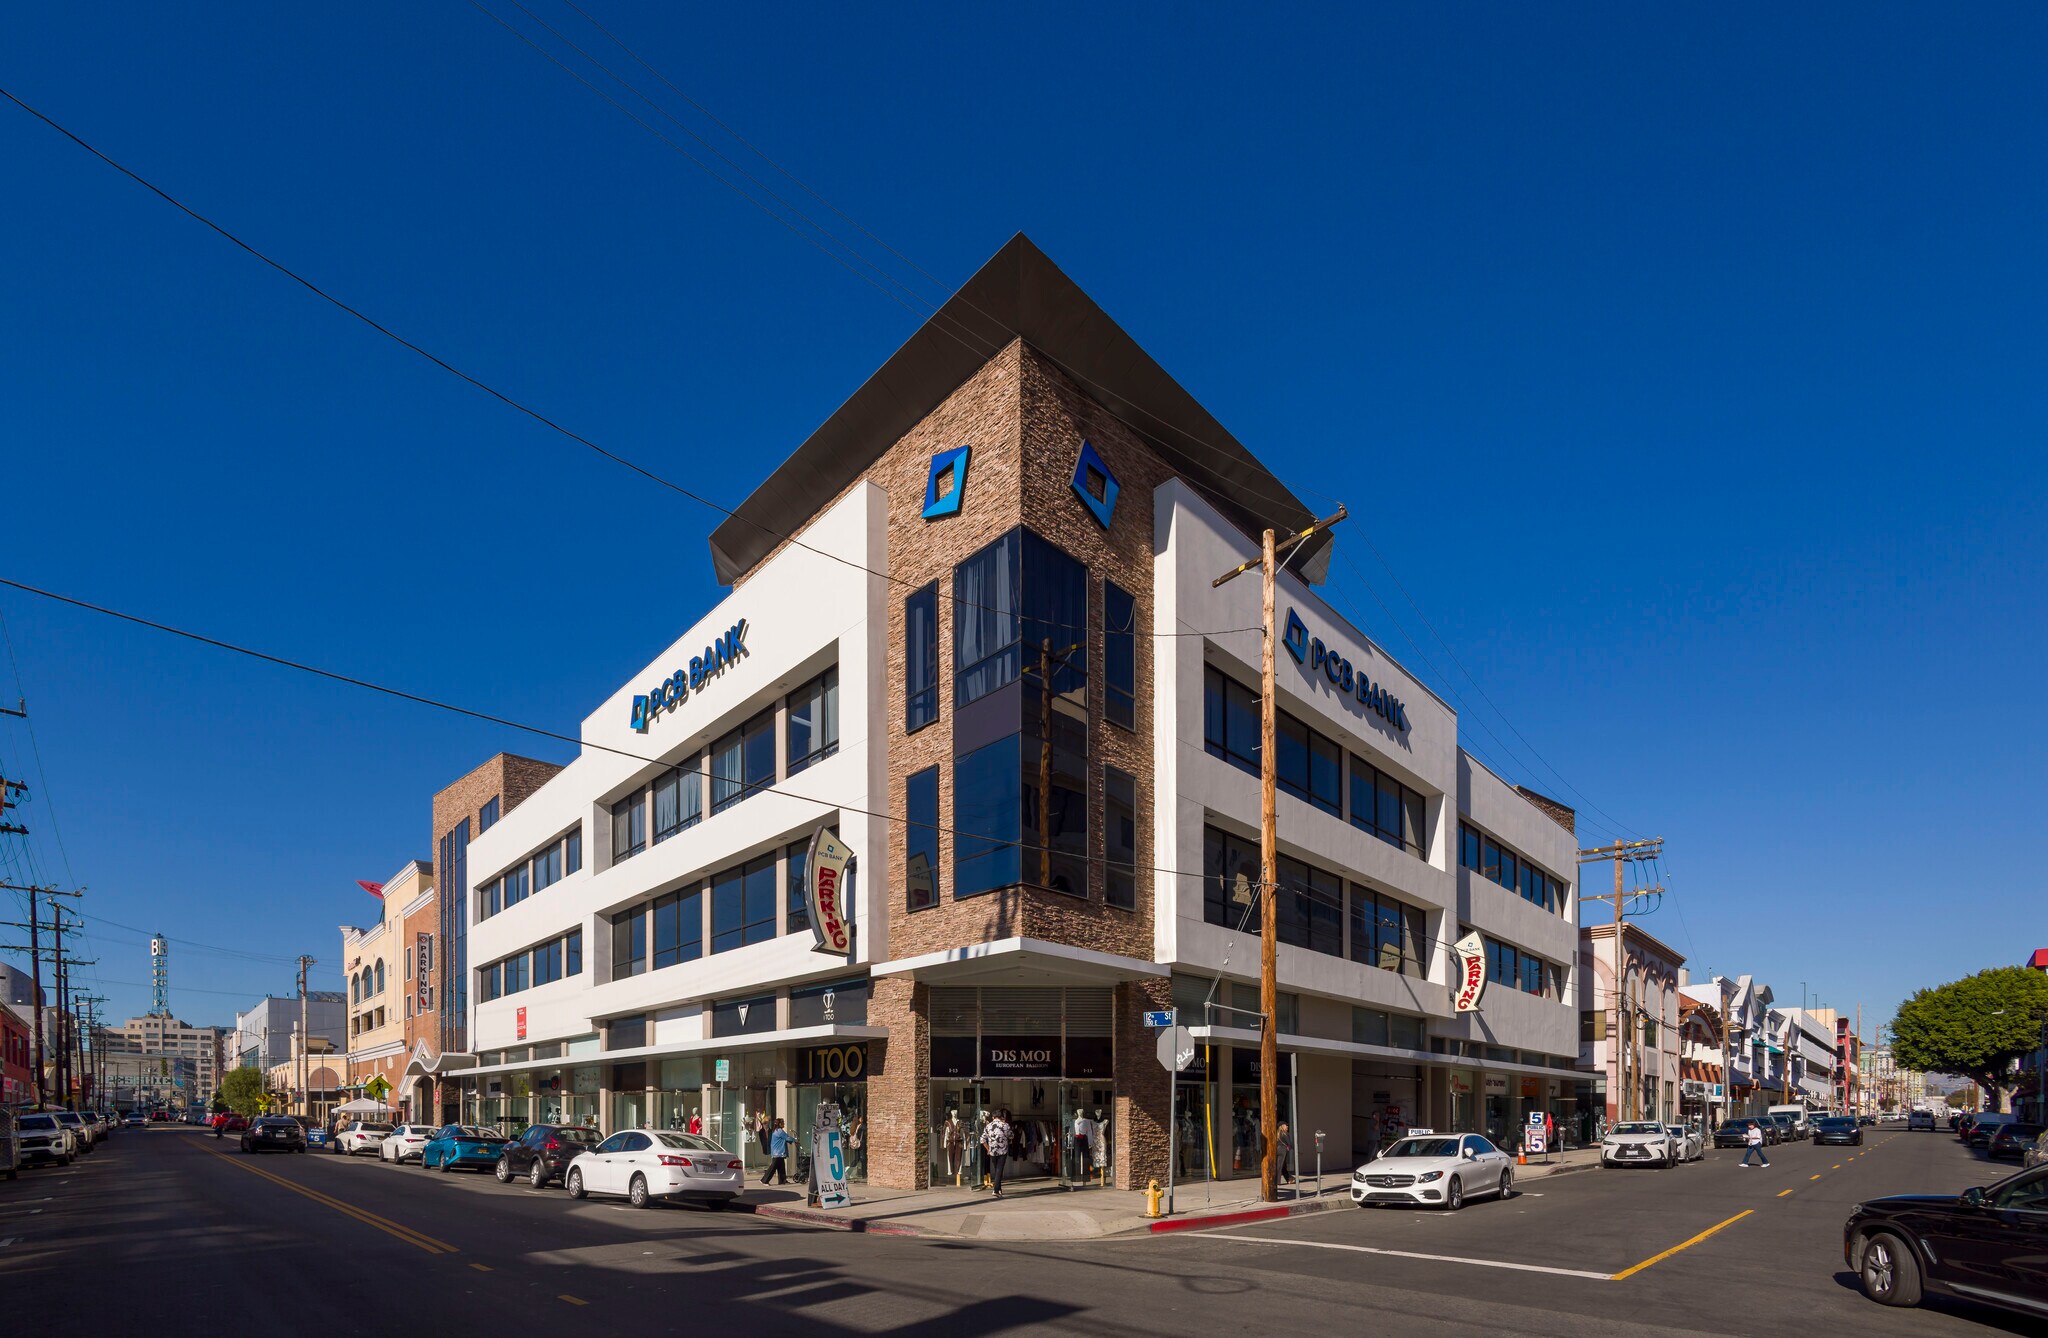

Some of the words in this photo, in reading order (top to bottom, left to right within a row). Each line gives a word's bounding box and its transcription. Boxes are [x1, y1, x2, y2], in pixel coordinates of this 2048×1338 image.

[650, 669, 686, 719] PCB
[689, 618, 746, 690] BANK
[1312, 636, 1353, 693] PCB
[1357, 671, 1405, 731] BANK
[829, 853, 843, 861] BANK
[818, 866, 848, 949] PARKING
[1457, 955, 1482, 1010] PARKING
[1164, 1012, 1172, 1020] St
[991, 1050, 1017, 1062] DIS
[1020, 1050, 1052, 1062] MOI
[822, 1110, 832, 1127] 5
[1531, 1113, 1542, 1124] 5
[1530, 1135, 1544, 1152] 5
[828, 1131, 844, 1181] 5
[821, 1184, 833, 1193] ALL
[834, 1182, 845, 1191] DAY
